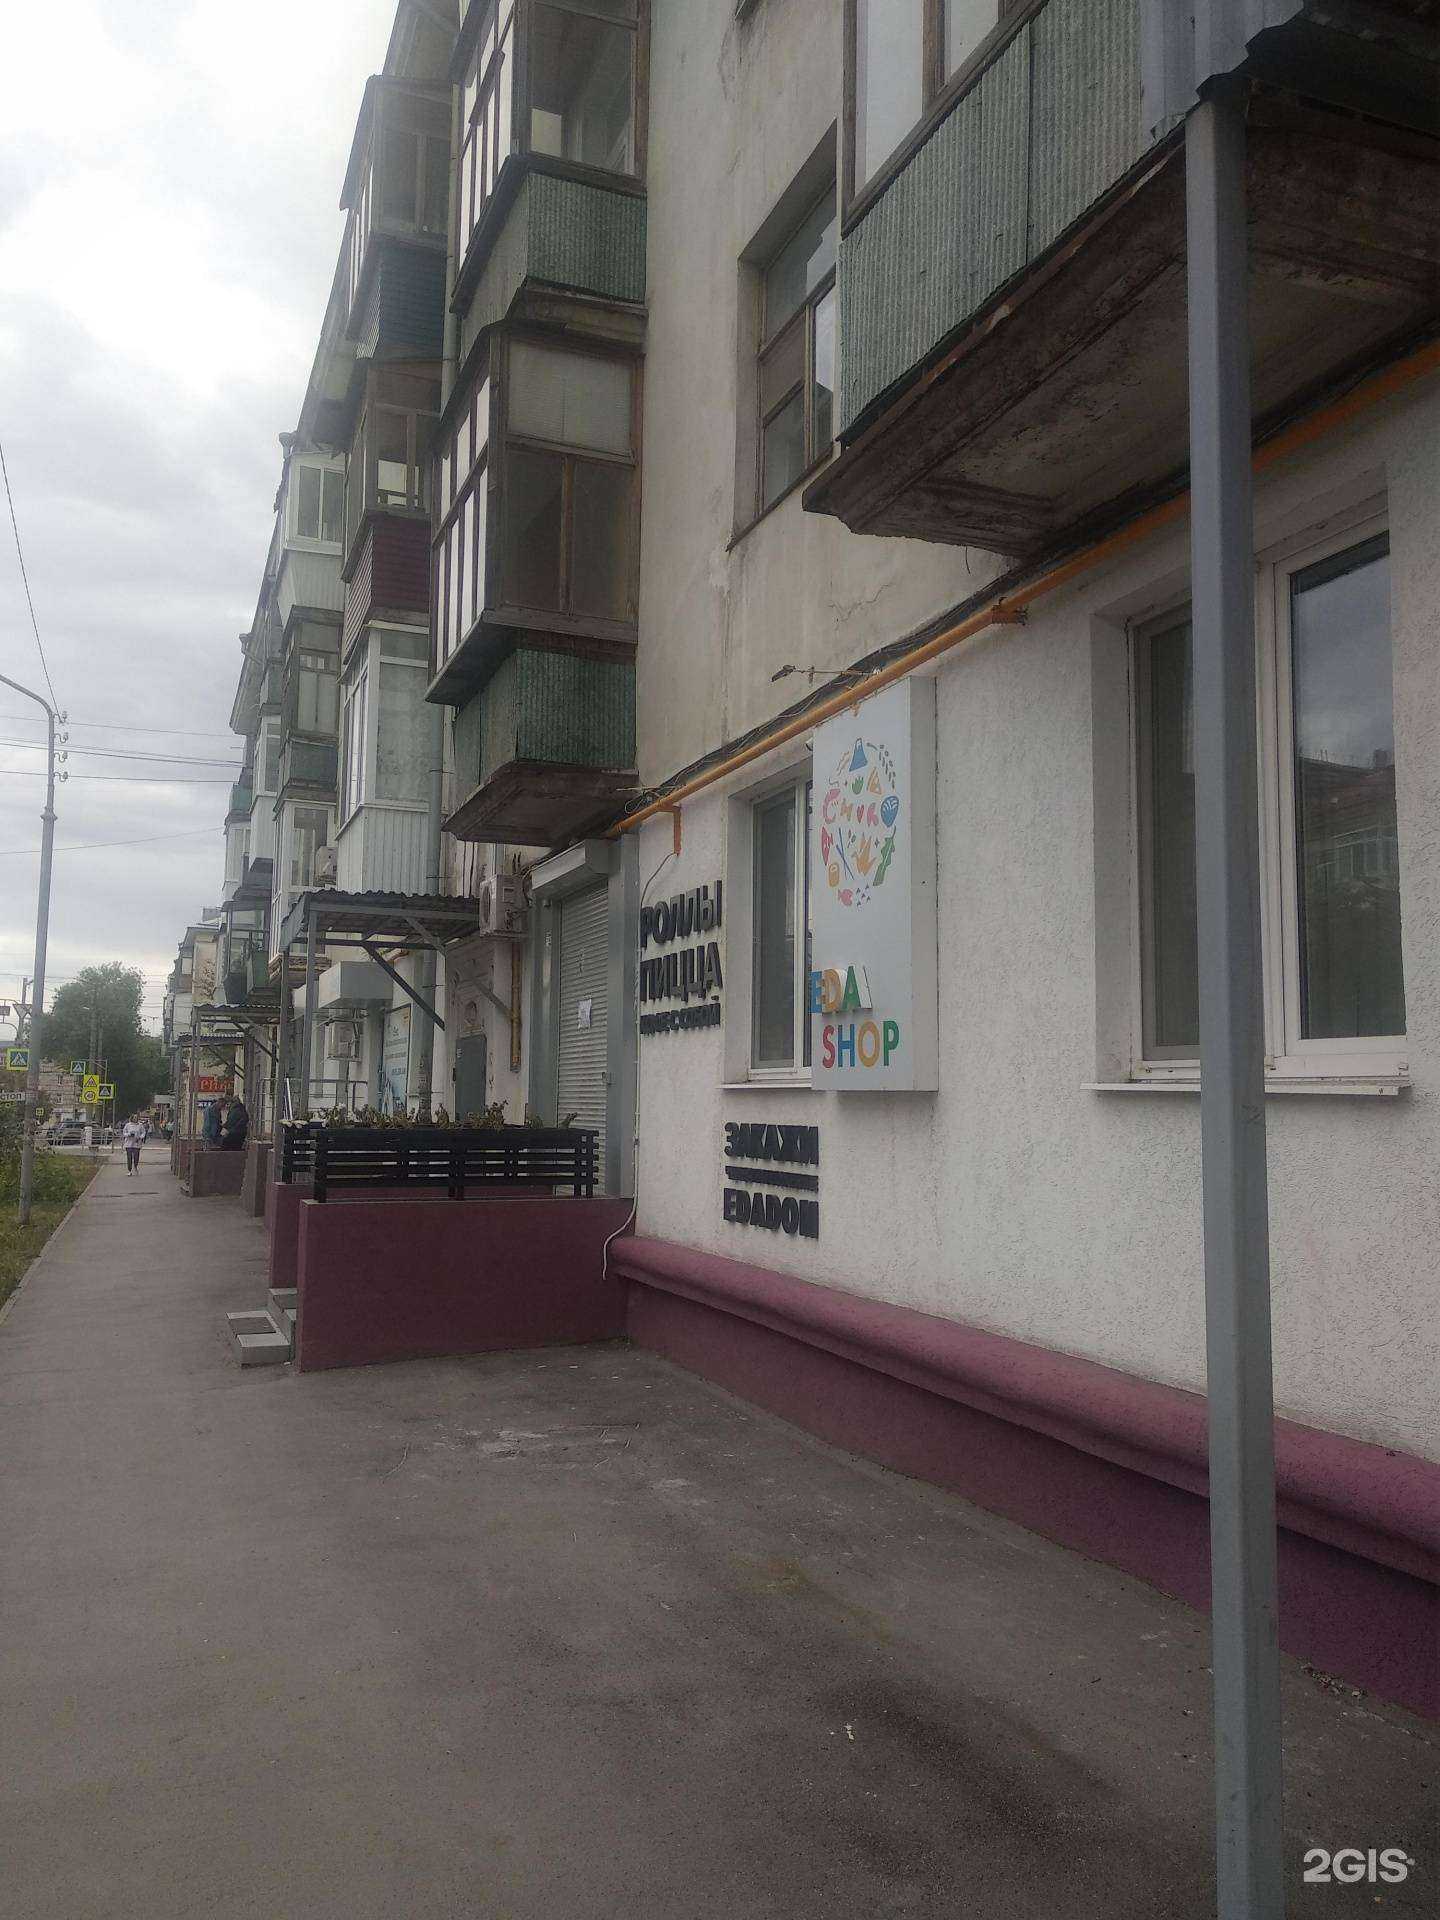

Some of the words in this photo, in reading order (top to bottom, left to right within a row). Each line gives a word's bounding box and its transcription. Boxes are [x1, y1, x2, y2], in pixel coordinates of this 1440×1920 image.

[641, 880, 722, 948] РОЛЛЫ
[640, 942, 723, 1001] ПИЦЦА
[808, 966, 866, 1013] EDA
[822, 1020, 900, 1069] SHOP
[724, 1122, 819, 1165] ЗАКАЖИ
